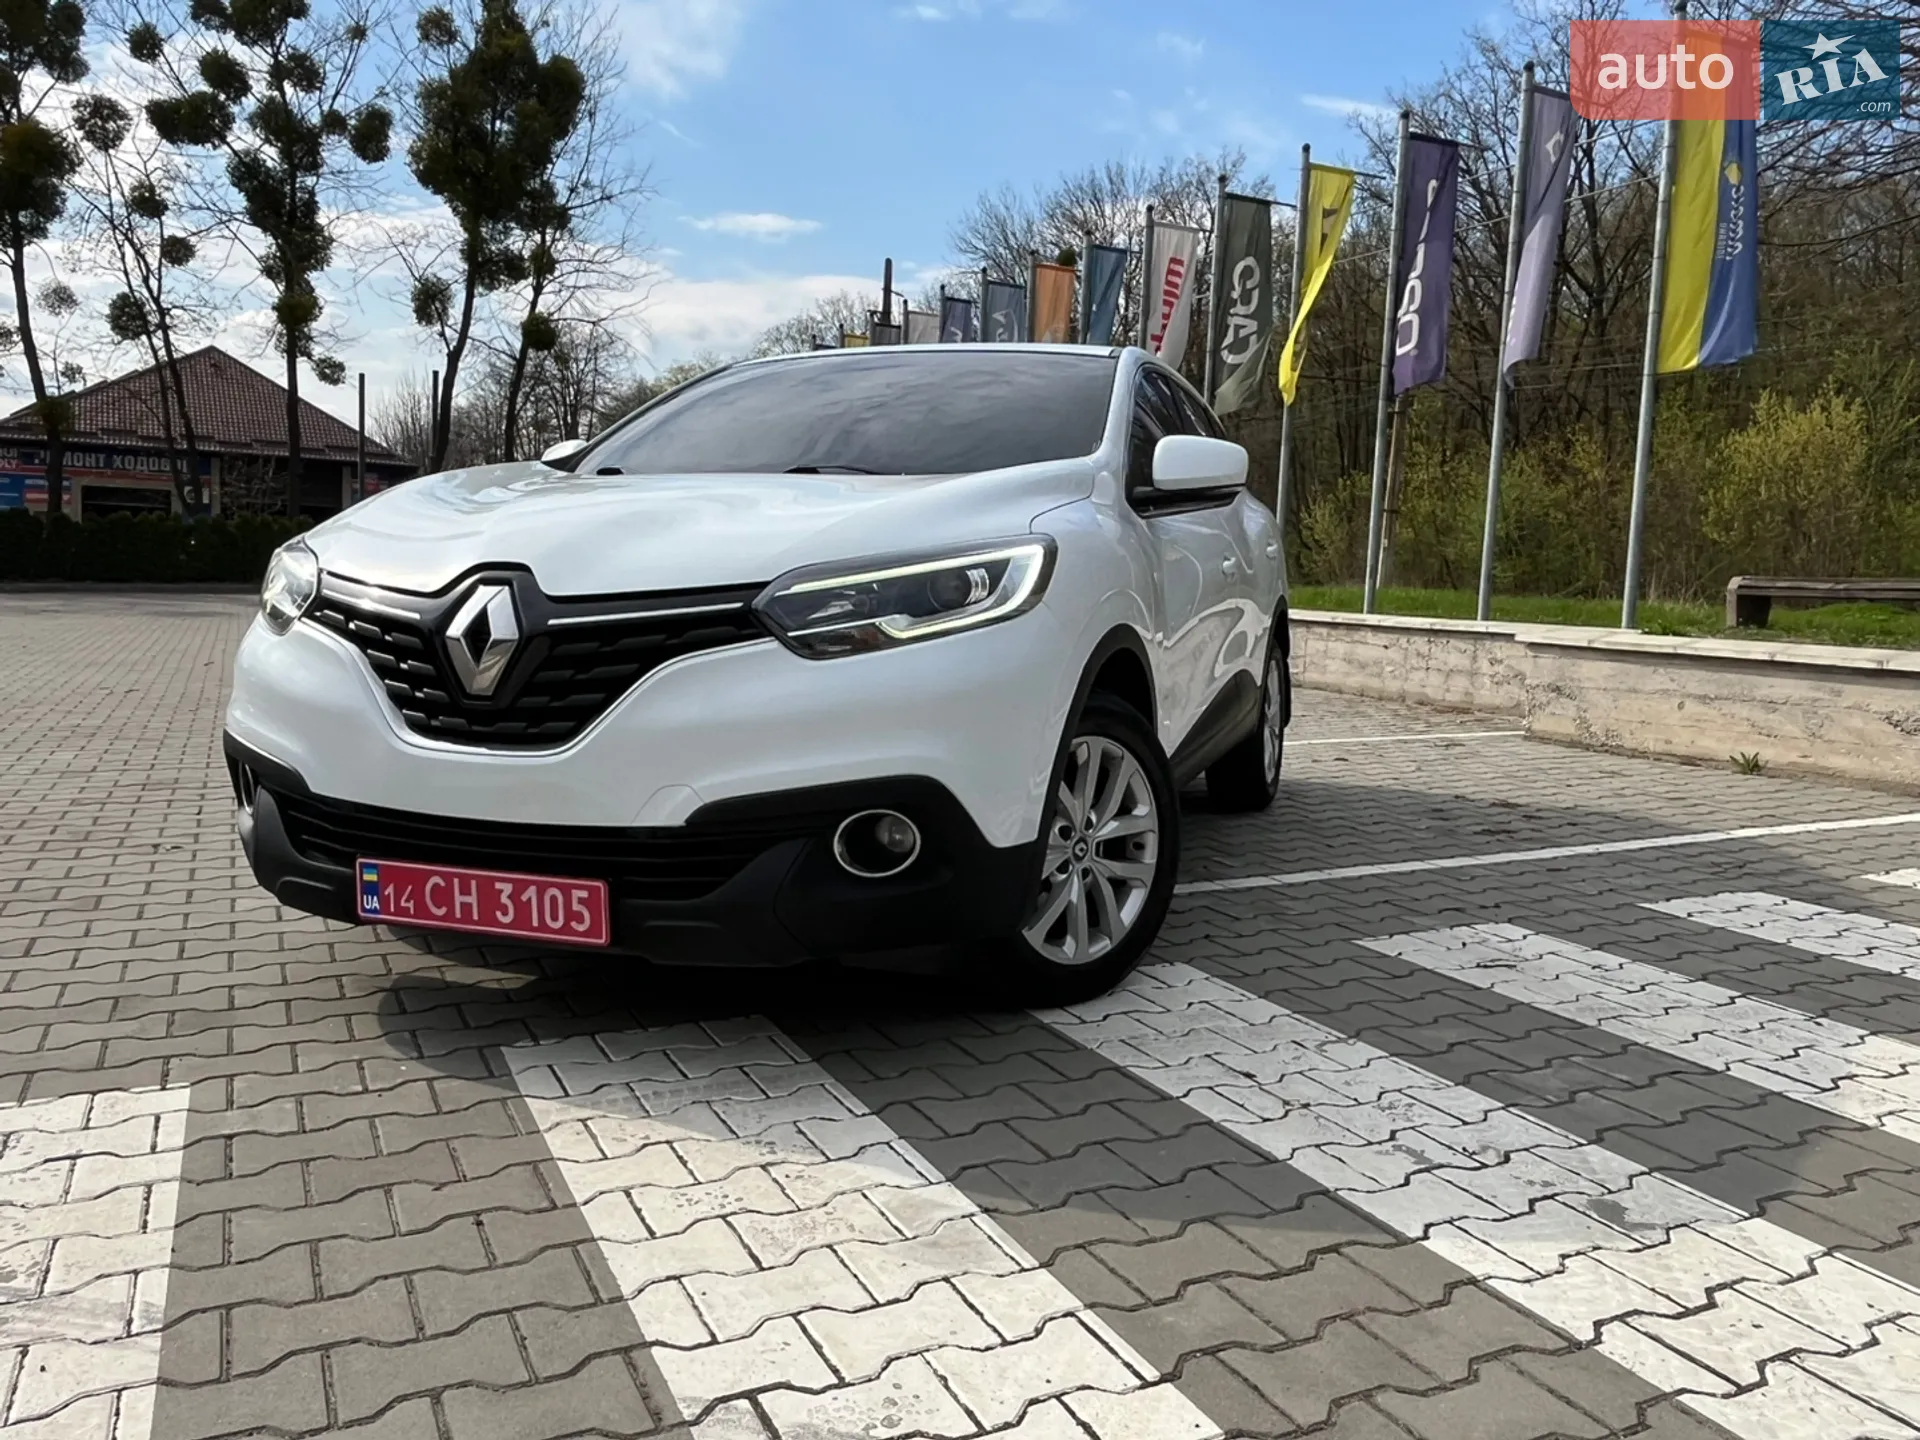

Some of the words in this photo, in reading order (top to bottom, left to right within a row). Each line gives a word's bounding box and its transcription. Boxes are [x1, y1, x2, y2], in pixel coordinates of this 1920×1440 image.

[363, 895, 380, 911] UA
[384, 882, 415, 915] 14
[425, 875, 479, 921] CH
[495, 882, 592, 932] 3105
